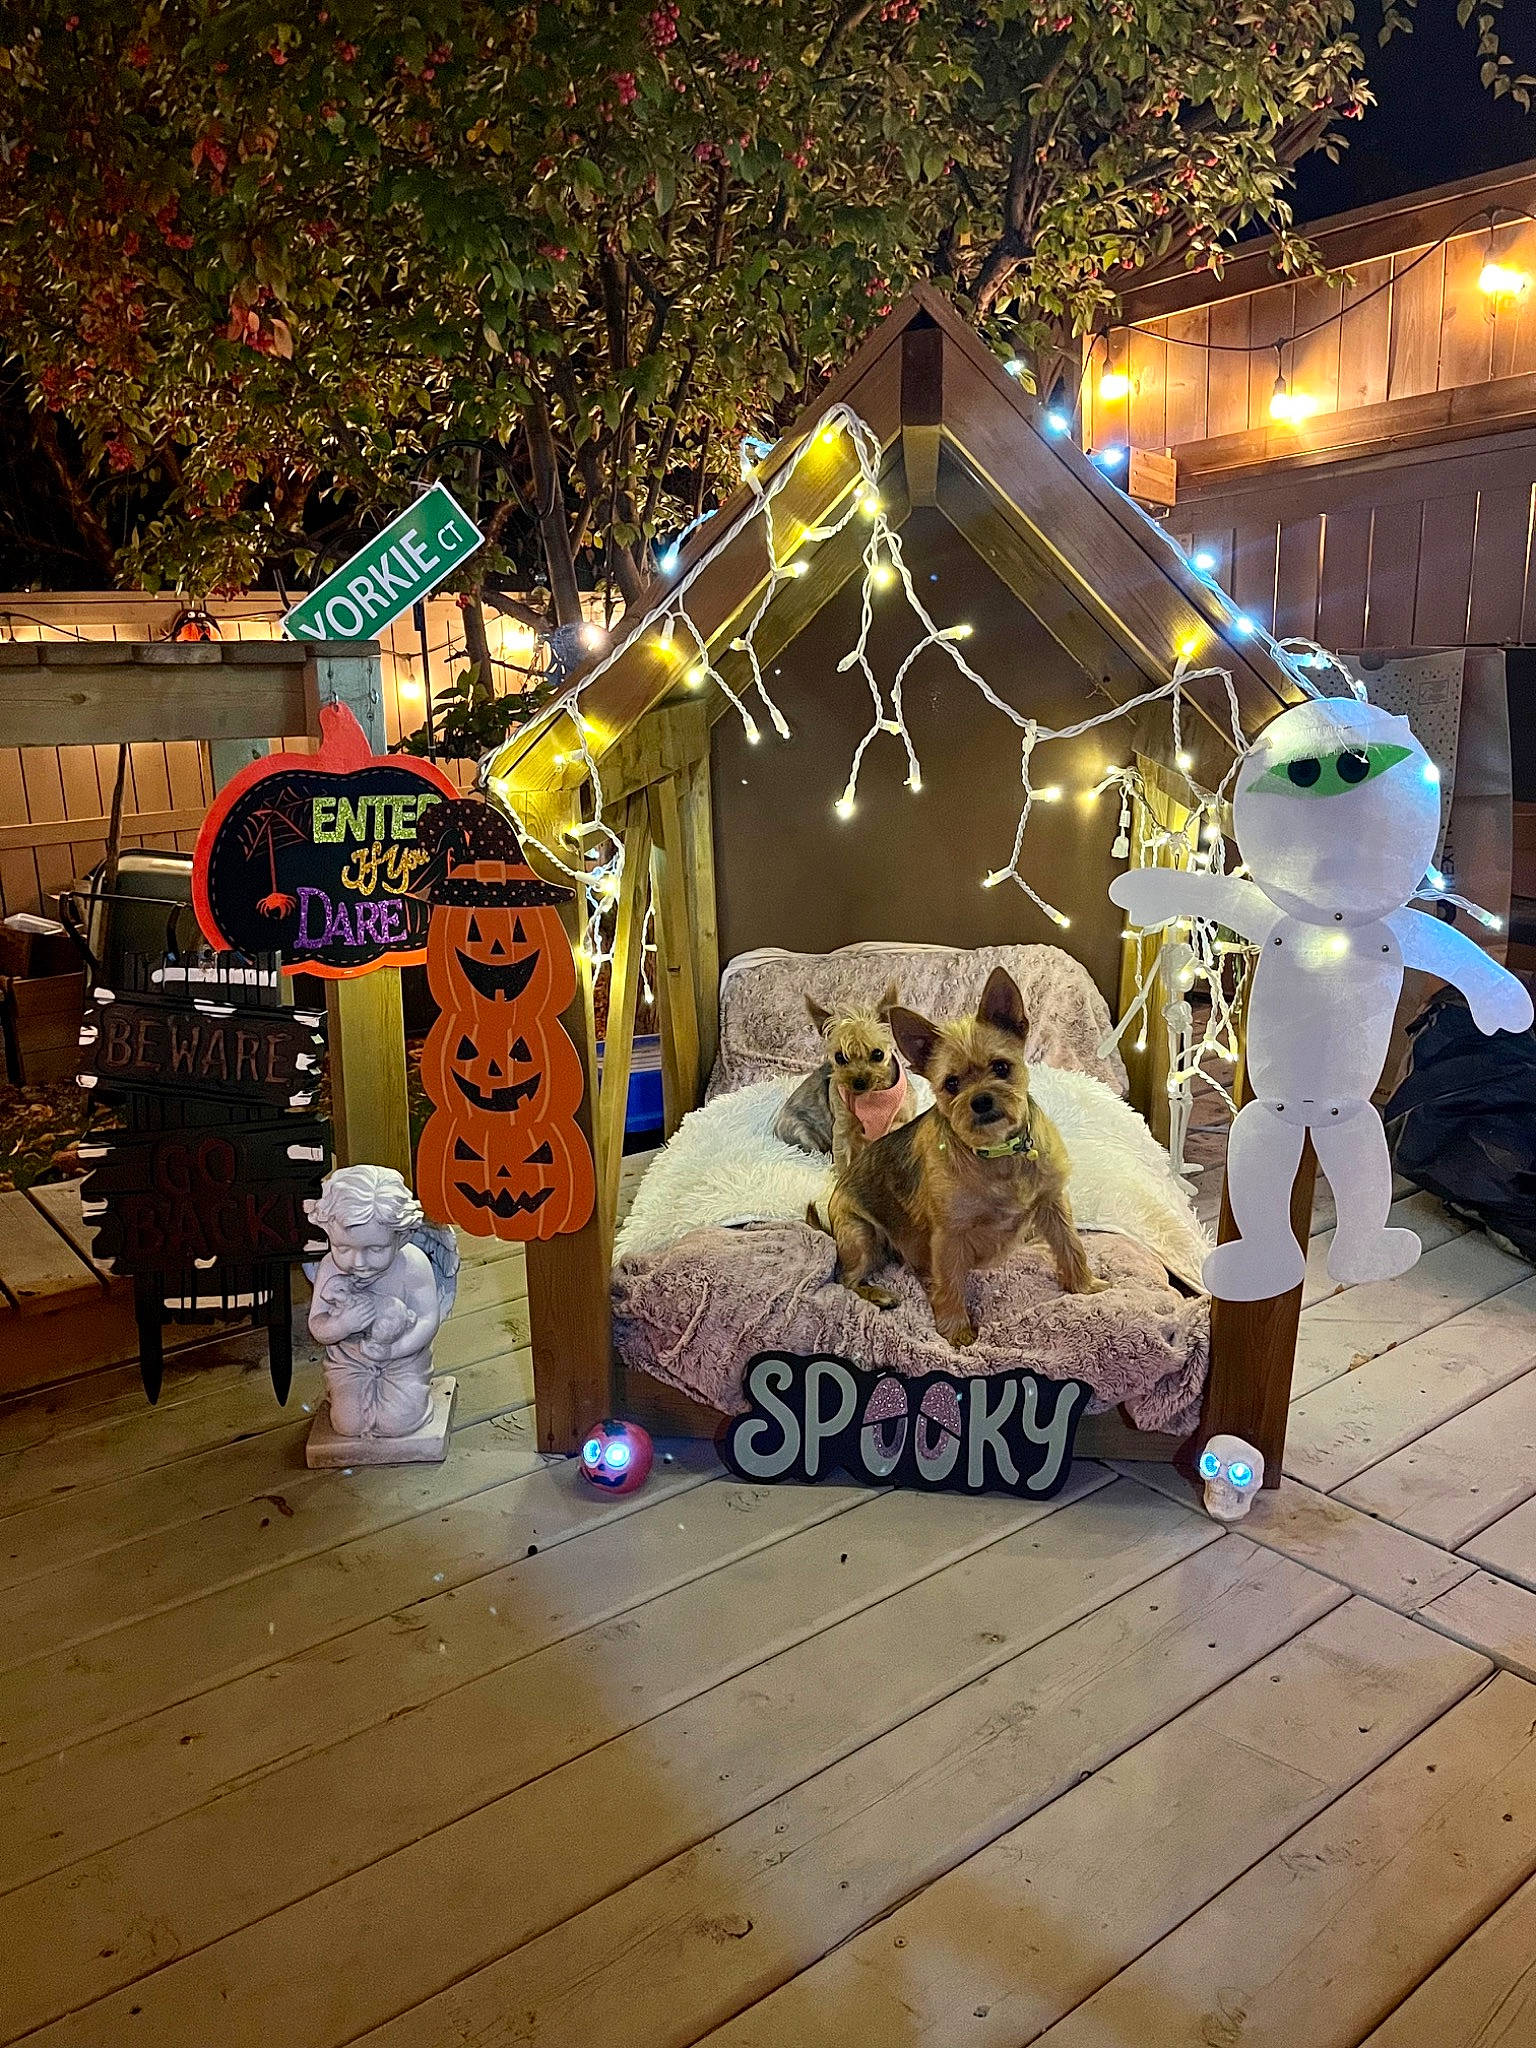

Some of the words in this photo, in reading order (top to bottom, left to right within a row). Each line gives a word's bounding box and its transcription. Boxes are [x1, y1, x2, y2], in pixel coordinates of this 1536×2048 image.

[298, 528, 441, 640] YORKIE
[437, 519, 464, 551] CT
[341, 841, 383, 896] If
[381, 844, 430, 894] You
[293, 887, 407, 948] DARE
[106, 1017, 293, 1086] BEWARE
[157, 1136, 236, 1194] GO
[733, 1359, 1081, 1491] SPOOKY
